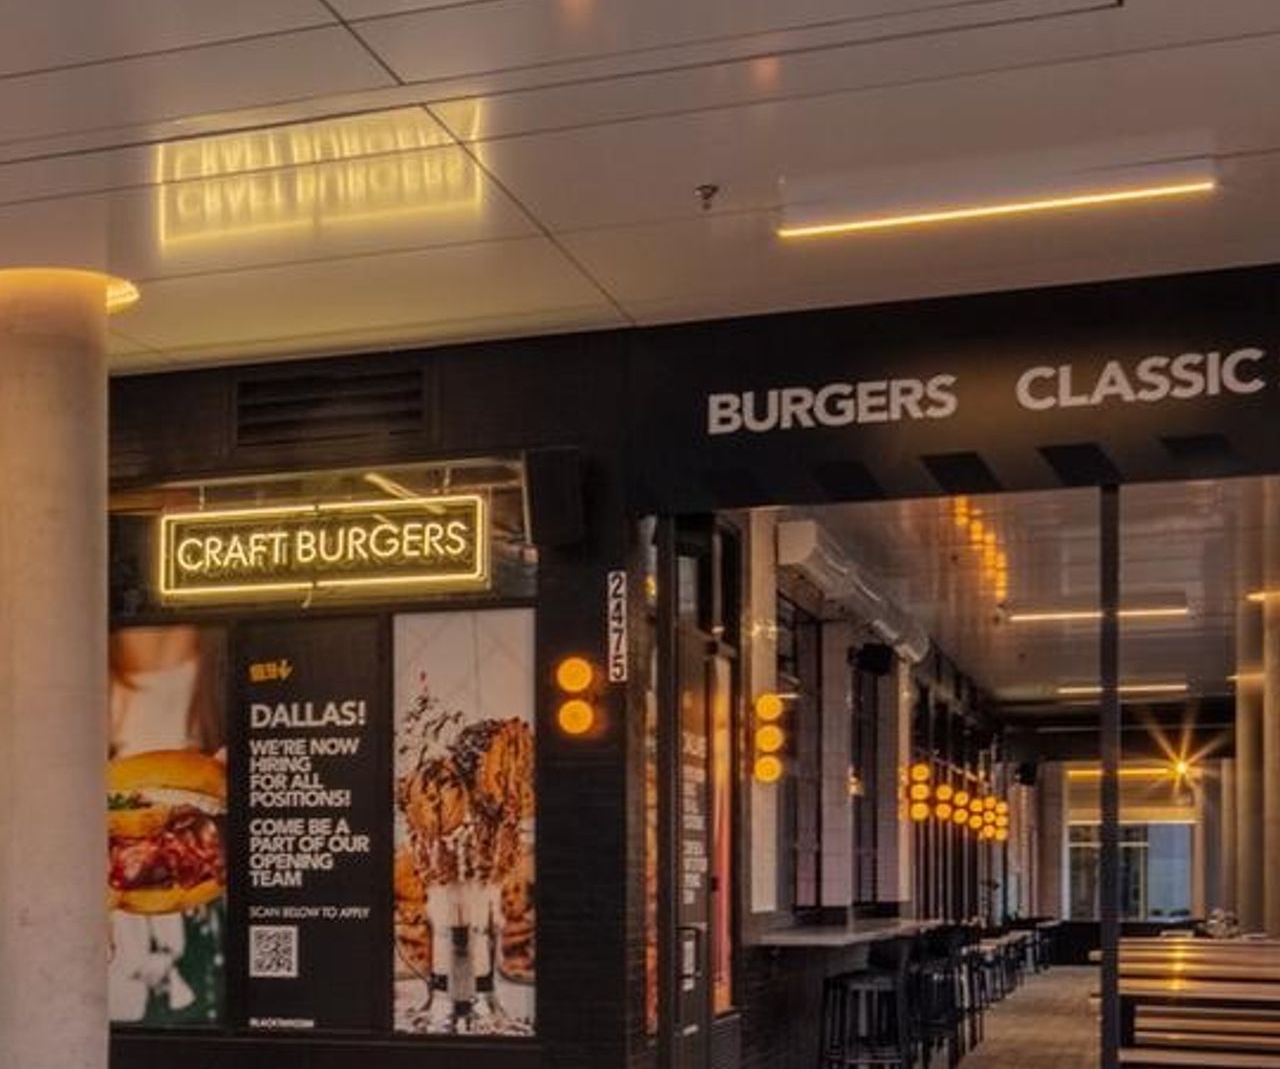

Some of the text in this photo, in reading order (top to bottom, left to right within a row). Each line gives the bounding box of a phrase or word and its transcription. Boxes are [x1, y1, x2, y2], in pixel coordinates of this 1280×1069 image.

[708, 375, 958, 435] BURGERS
[1016, 347, 1264, 411] CLASSIC
[177, 522, 468, 571] CRAFT BURGERS
[610, 572, 625, 680] 2475
[251, 700, 366, 728] DALLAS!
[250, 737, 359, 755] WE'RE NOW
[250, 756, 312, 773] HIRING
[250, 772, 323, 790] FOR ALL
[250, 789, 351, 807] POSITIONS!
[250, 817, 351, 835] COME BE A
[250, 834, 370, 852] PART OF OUR
[250, 852, 333, 869] OPENING
[249, 870, 302, 887] TEAM
